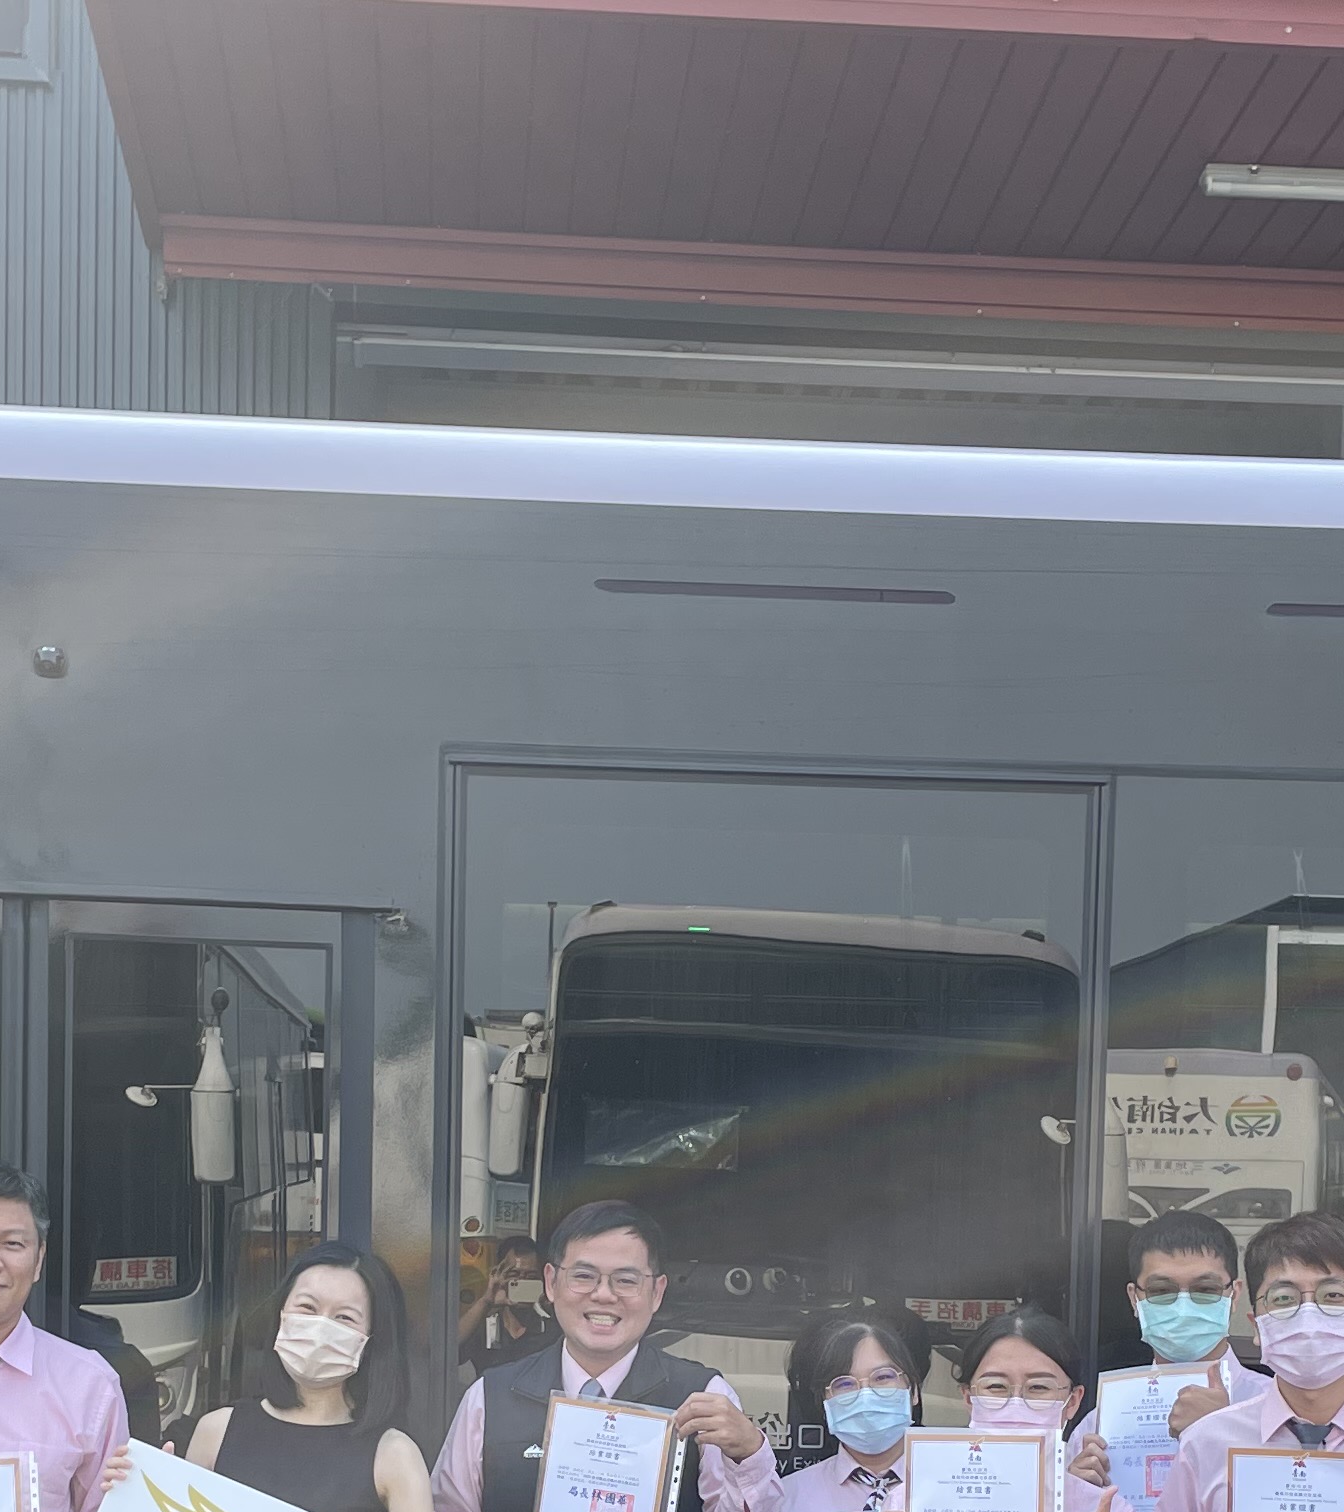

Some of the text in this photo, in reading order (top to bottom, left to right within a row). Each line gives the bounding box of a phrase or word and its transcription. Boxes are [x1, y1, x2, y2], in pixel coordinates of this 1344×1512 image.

[568, 1485, 628, 1506] 局長林國華
